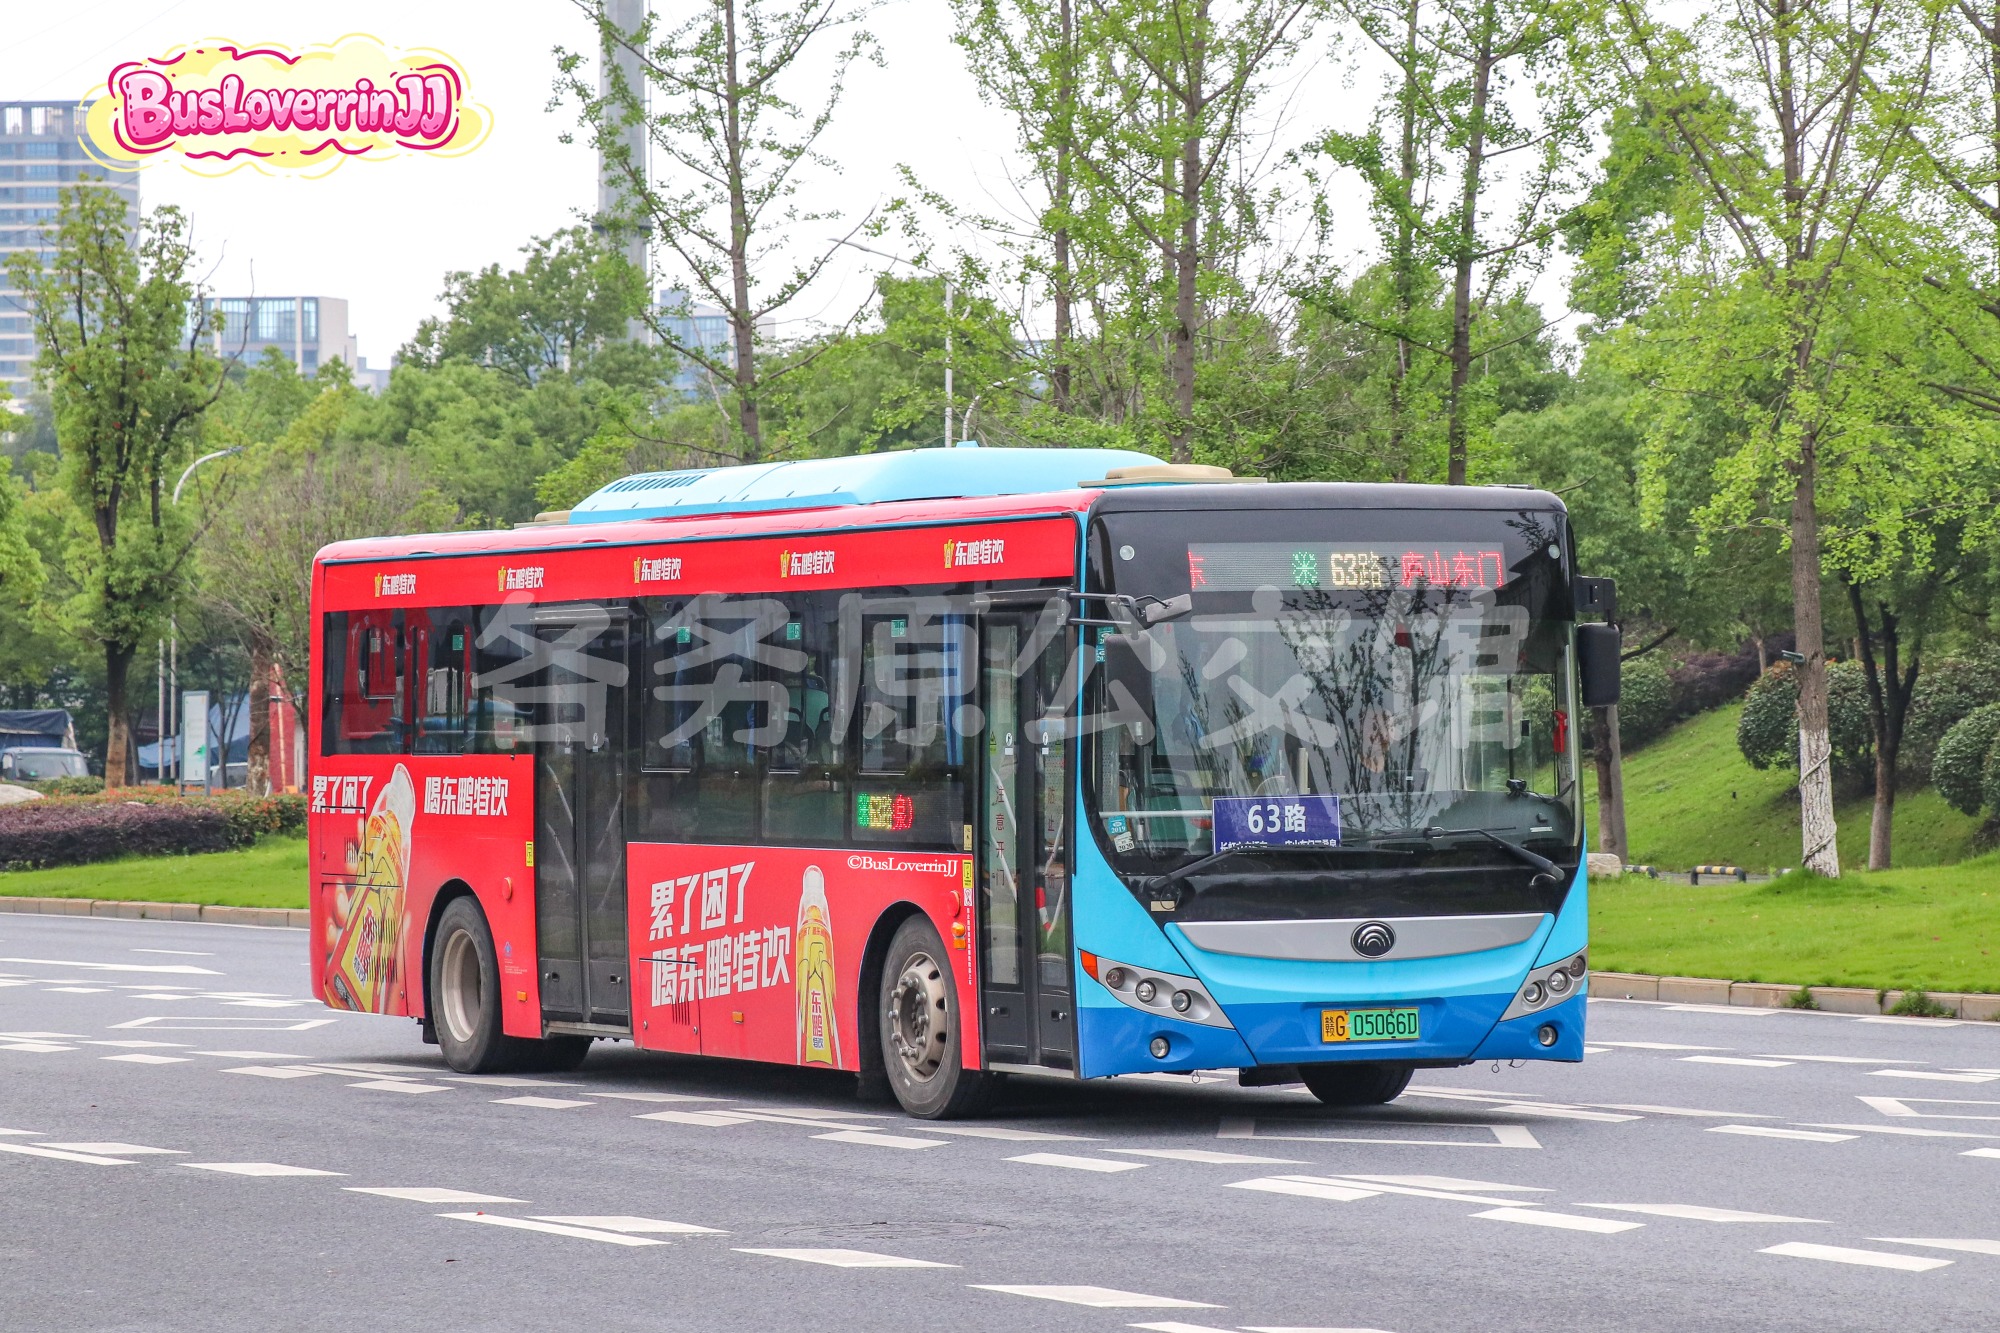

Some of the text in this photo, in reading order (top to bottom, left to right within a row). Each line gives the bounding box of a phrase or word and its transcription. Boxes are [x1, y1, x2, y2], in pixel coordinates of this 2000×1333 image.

[790, 550, 835, 575] 东鹏特饮
[955, 539, 1004, 566] 东鹏特饮
[506, 566, 544, 590] 东鹏特饮
[641, 557, 682, 581] 东鹏特饮
[1331, 551, 1382, 587] 63路
[1401, 551, 1504, 588] 庐山东门
[382, 573, 417, 595] 东鹏特饮
[311, 775, 374, 814] 累了困了
[423, 776, 509, 816] 喝东鹏特饮
[1111, 826, 1126, 834] 2019
[1247, 803, 1307, 834] 63路
[1118, 843, 1133, 851] 2020
[649, 861, 756, 941] 累了困了
[651, 924, 791, 1007] 喝东鹏特饮
